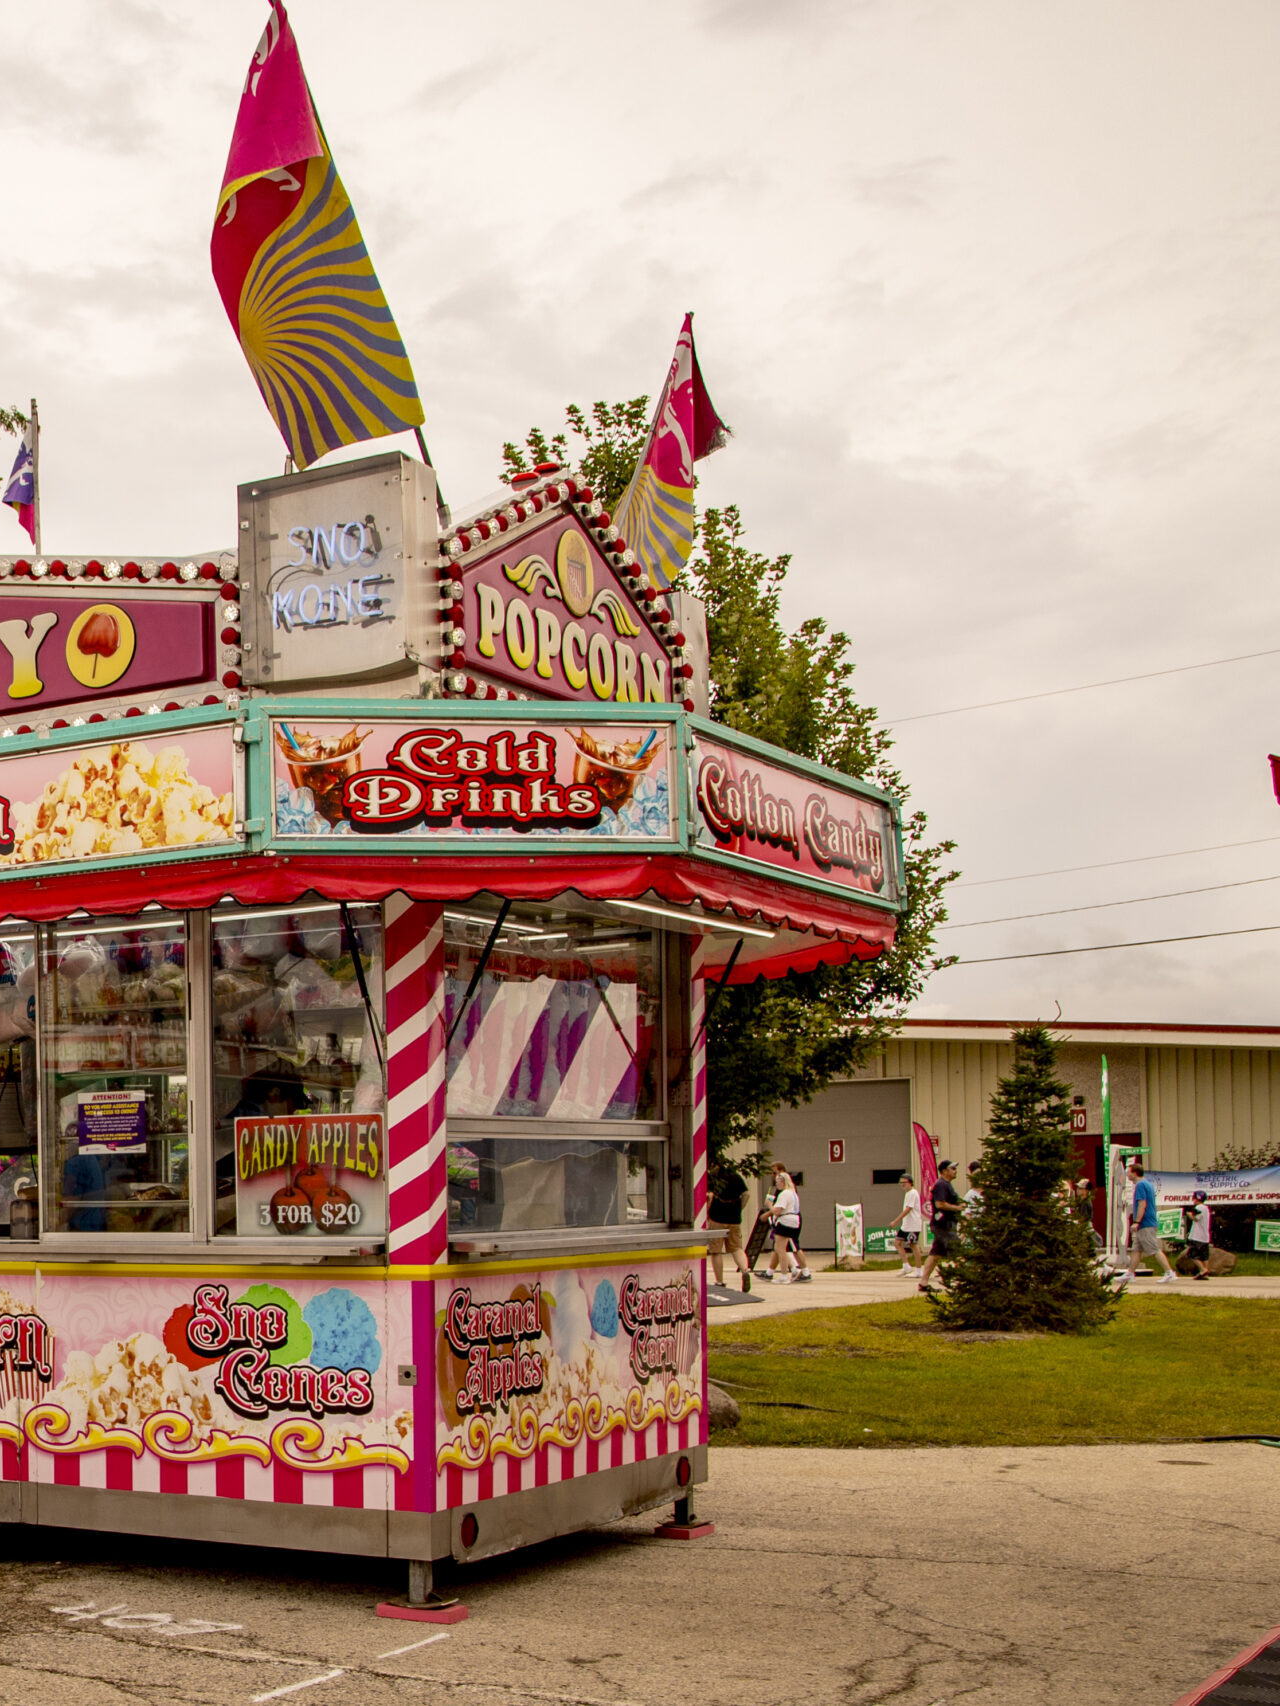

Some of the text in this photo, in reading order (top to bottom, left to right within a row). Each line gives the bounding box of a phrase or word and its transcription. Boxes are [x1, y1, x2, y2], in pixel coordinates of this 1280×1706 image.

[287, 520, 365, 567] SNO
[271, 573, 384, 630] KONE
[476, 581, 667, 702] POPCORN
[392, 728, 556, 780] Cold
[344, 770, 601, 822] Drinks
[698, 756, 883, 883] Cotton Candy
[1073, 1114, 1085, 1128] 10
[238, 1121, 379, 1180] CANDY APPLES
[833, 1144, 841, 1158] 9
[260, 1201, 361, 1226] 3 FOR $20
[1164, 1194, 1190, 1202] FORUM
[867, 1230, 884, 1243] JOIN
[187, 1284, 288, 1356] Sno
[446, 1283, 542, 1352] Caramel
[619, 1270, 694, 1331] Caramel
[457, 1342, 544, 1410] Apples
[630, 1326, 677, 1380] Corn
[215, 1346, 375, 1419] Cones
